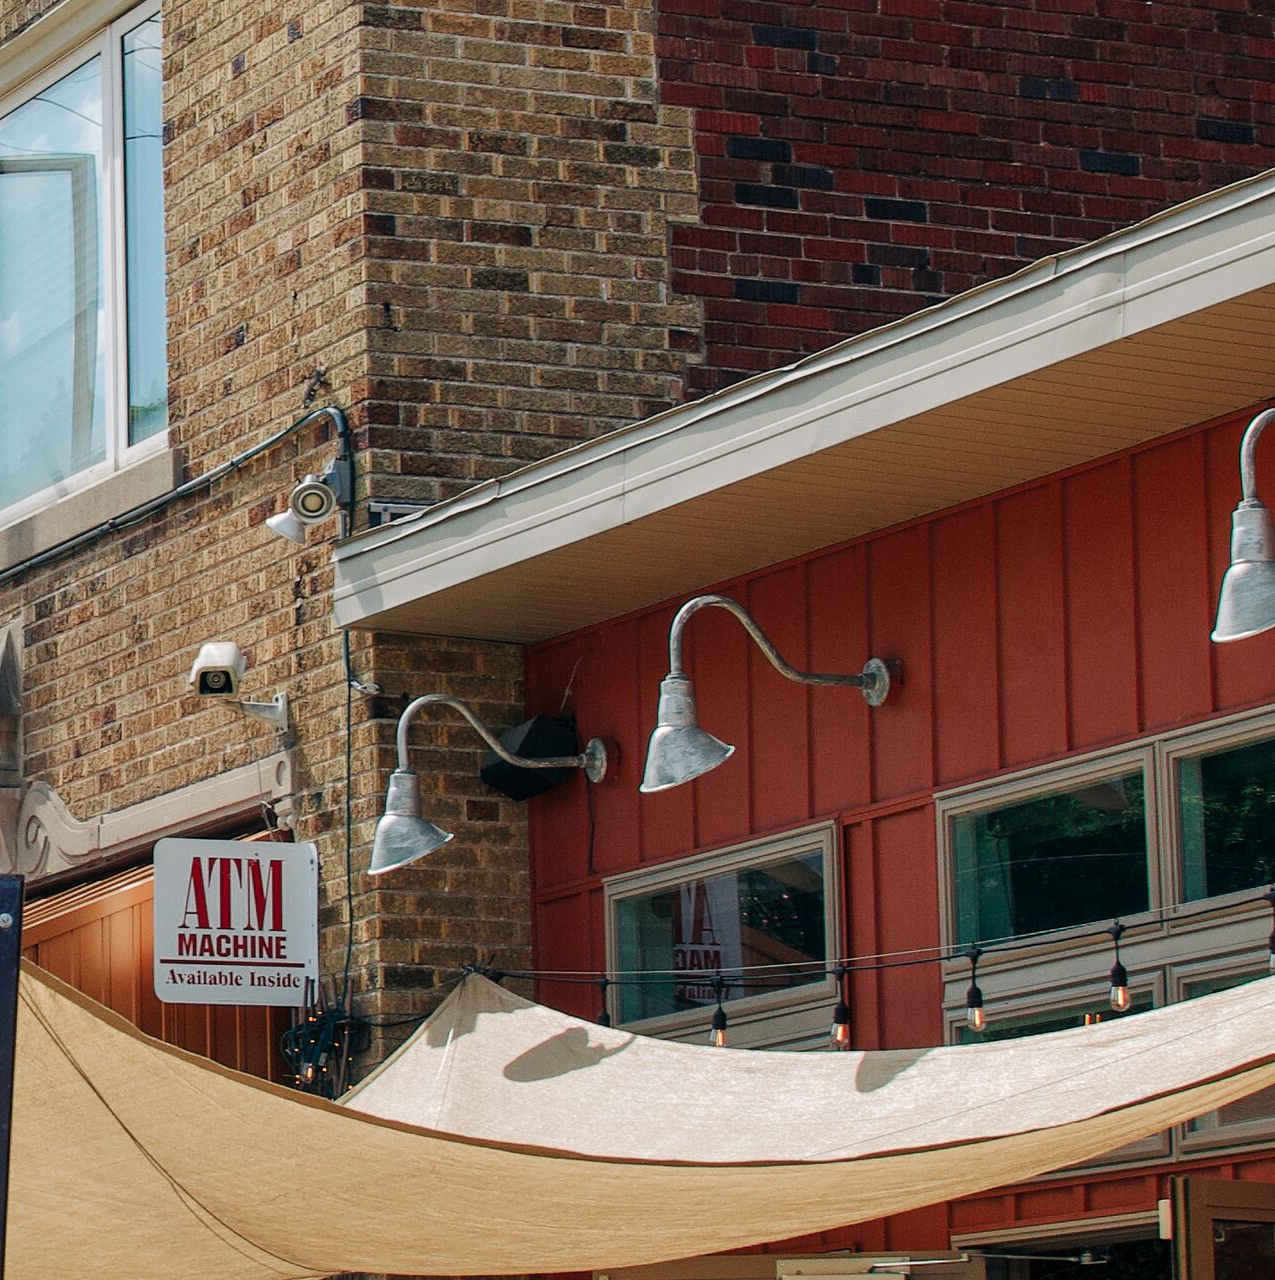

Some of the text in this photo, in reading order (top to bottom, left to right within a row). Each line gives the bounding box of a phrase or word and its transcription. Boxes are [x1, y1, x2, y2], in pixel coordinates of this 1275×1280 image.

[177, 856, 287, 932] ATM
[177, 933, 287, 960] MACHINE
[165, 969, 301, 988] Available Inside
